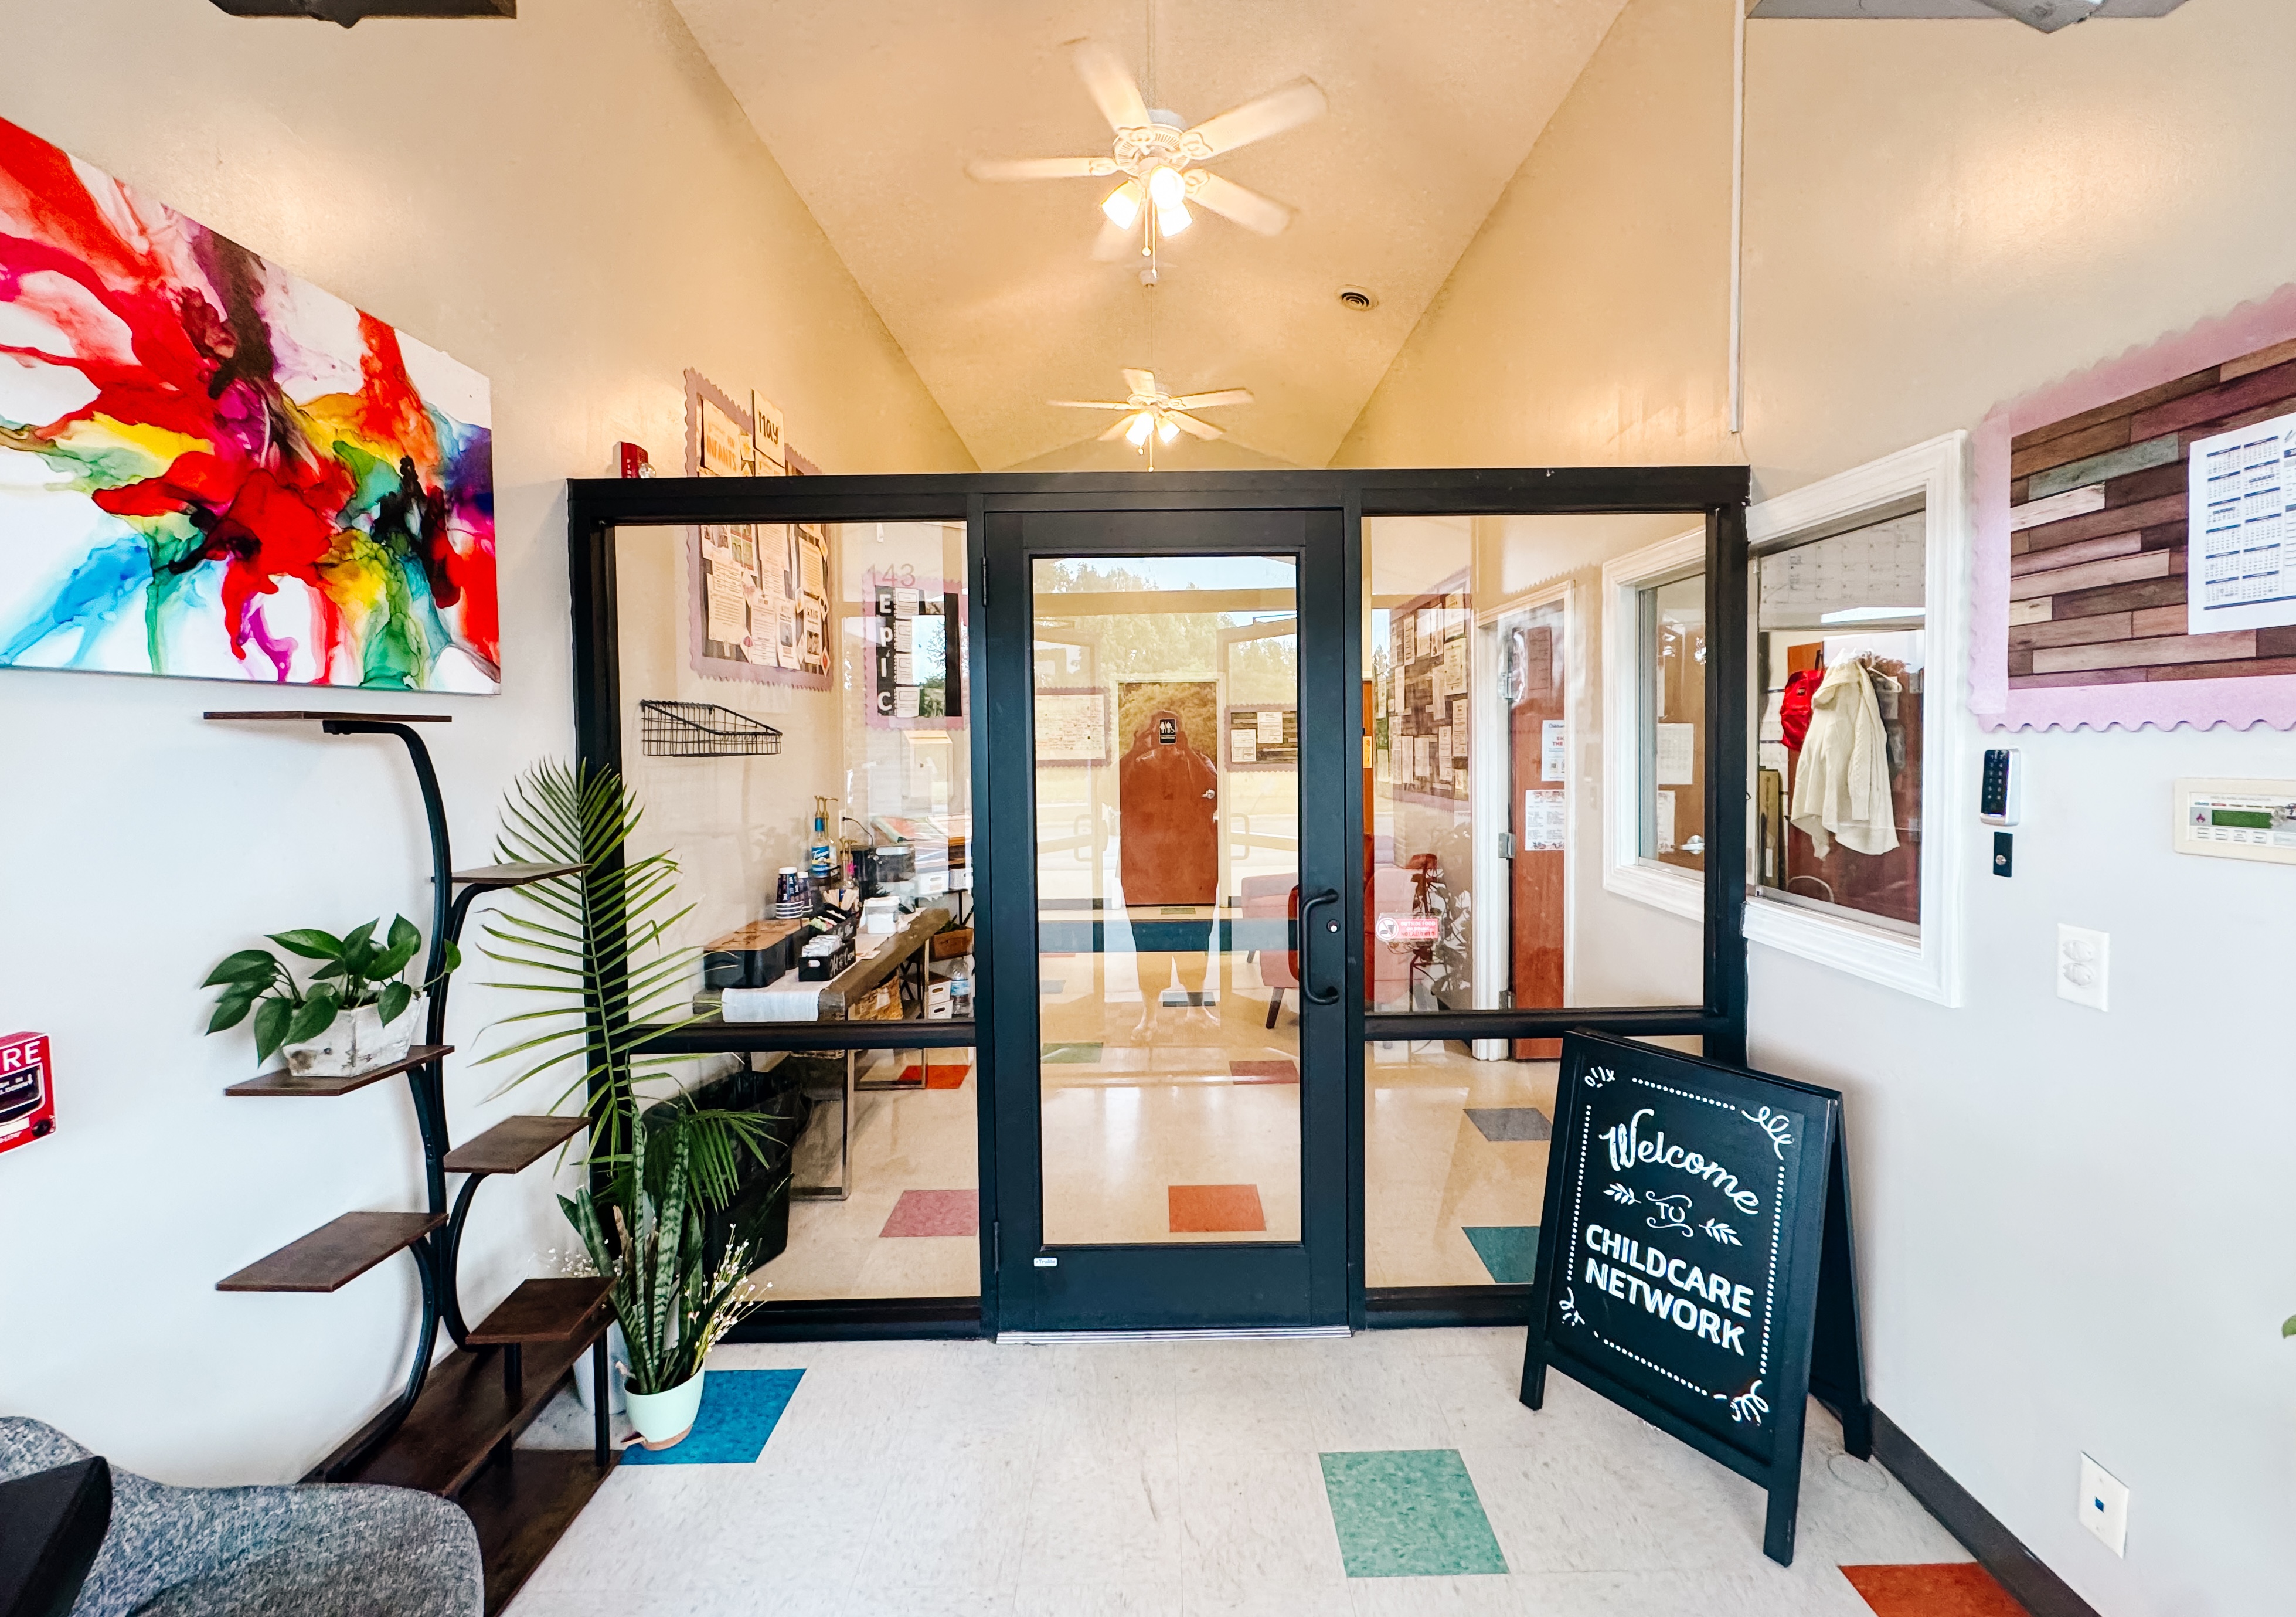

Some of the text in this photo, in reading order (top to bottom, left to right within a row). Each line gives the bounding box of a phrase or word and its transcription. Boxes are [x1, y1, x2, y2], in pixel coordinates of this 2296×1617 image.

[758, 411, 778, 445] May
[867, 563, 916, 587] 143
[2, 1041, 42, 1072] RE
[1598, 1109, 1759, 1215] Welcome
[1656, 1202, 1685, 1223] TO
[1586, 1224, 1754, 1318] CHILDCARE
[1585, 1257, 1744, 1356] NETWORK
